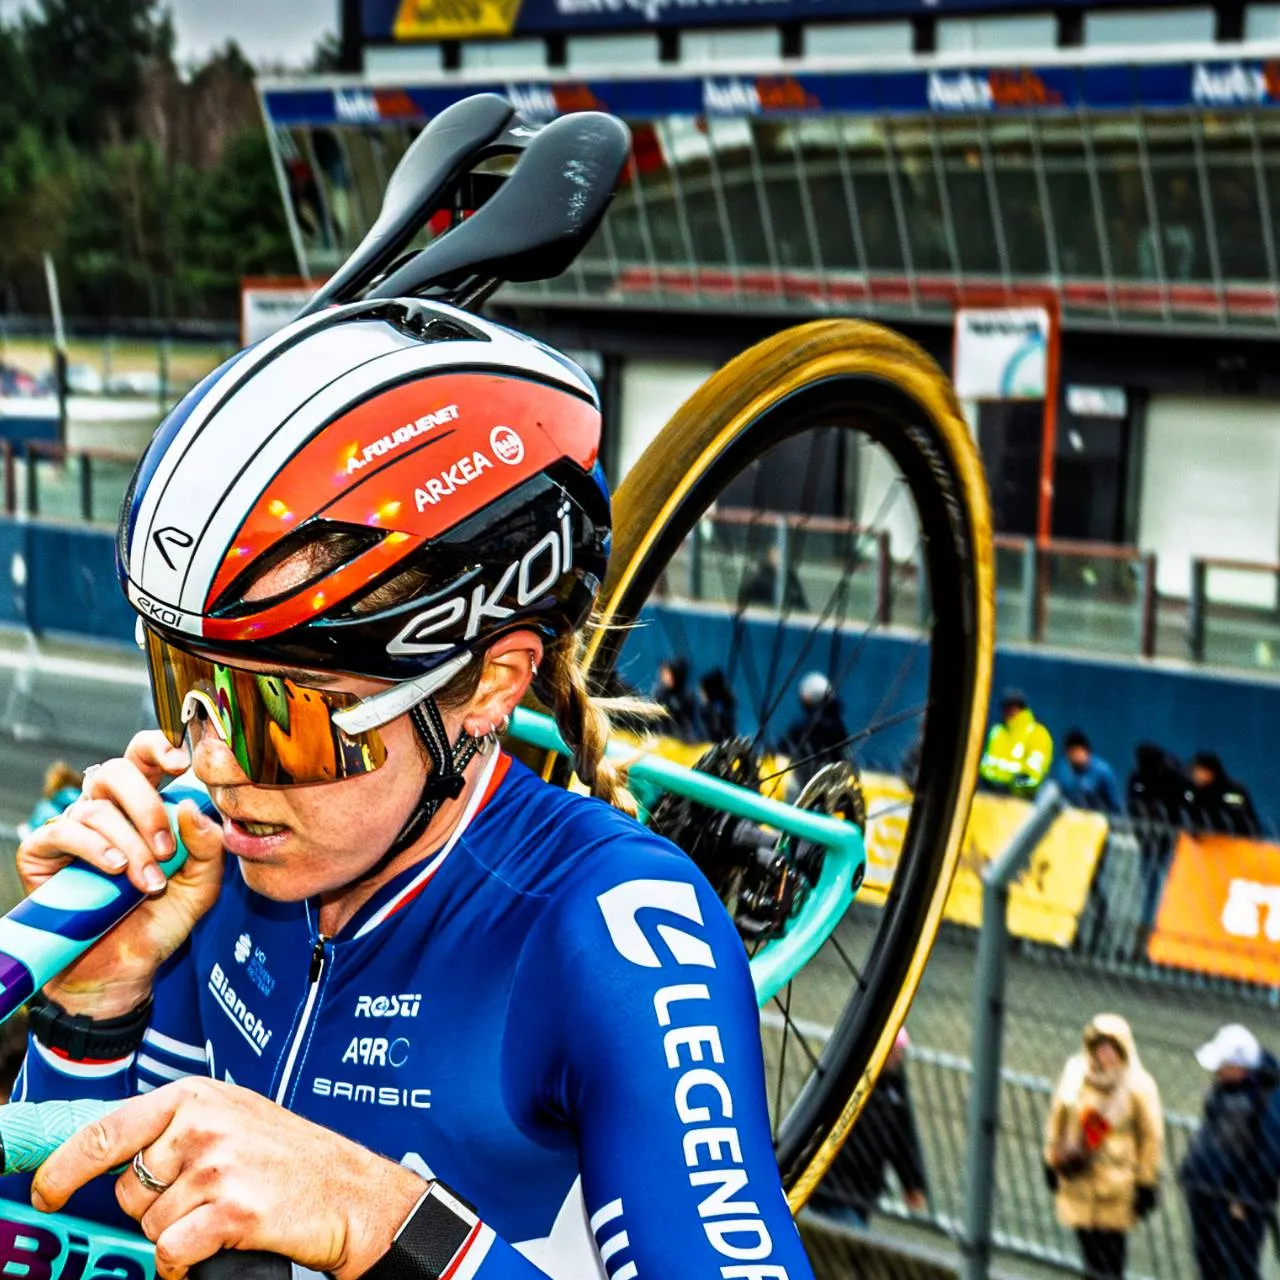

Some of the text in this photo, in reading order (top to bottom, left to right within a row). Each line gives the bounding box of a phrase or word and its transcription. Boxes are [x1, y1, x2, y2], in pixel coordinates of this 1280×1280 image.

[414, 451, 493, 513] ARKEA
[210, 962, 273, 1050] Bianchi
[312, 1077, 432, 1109] SAMSIC
